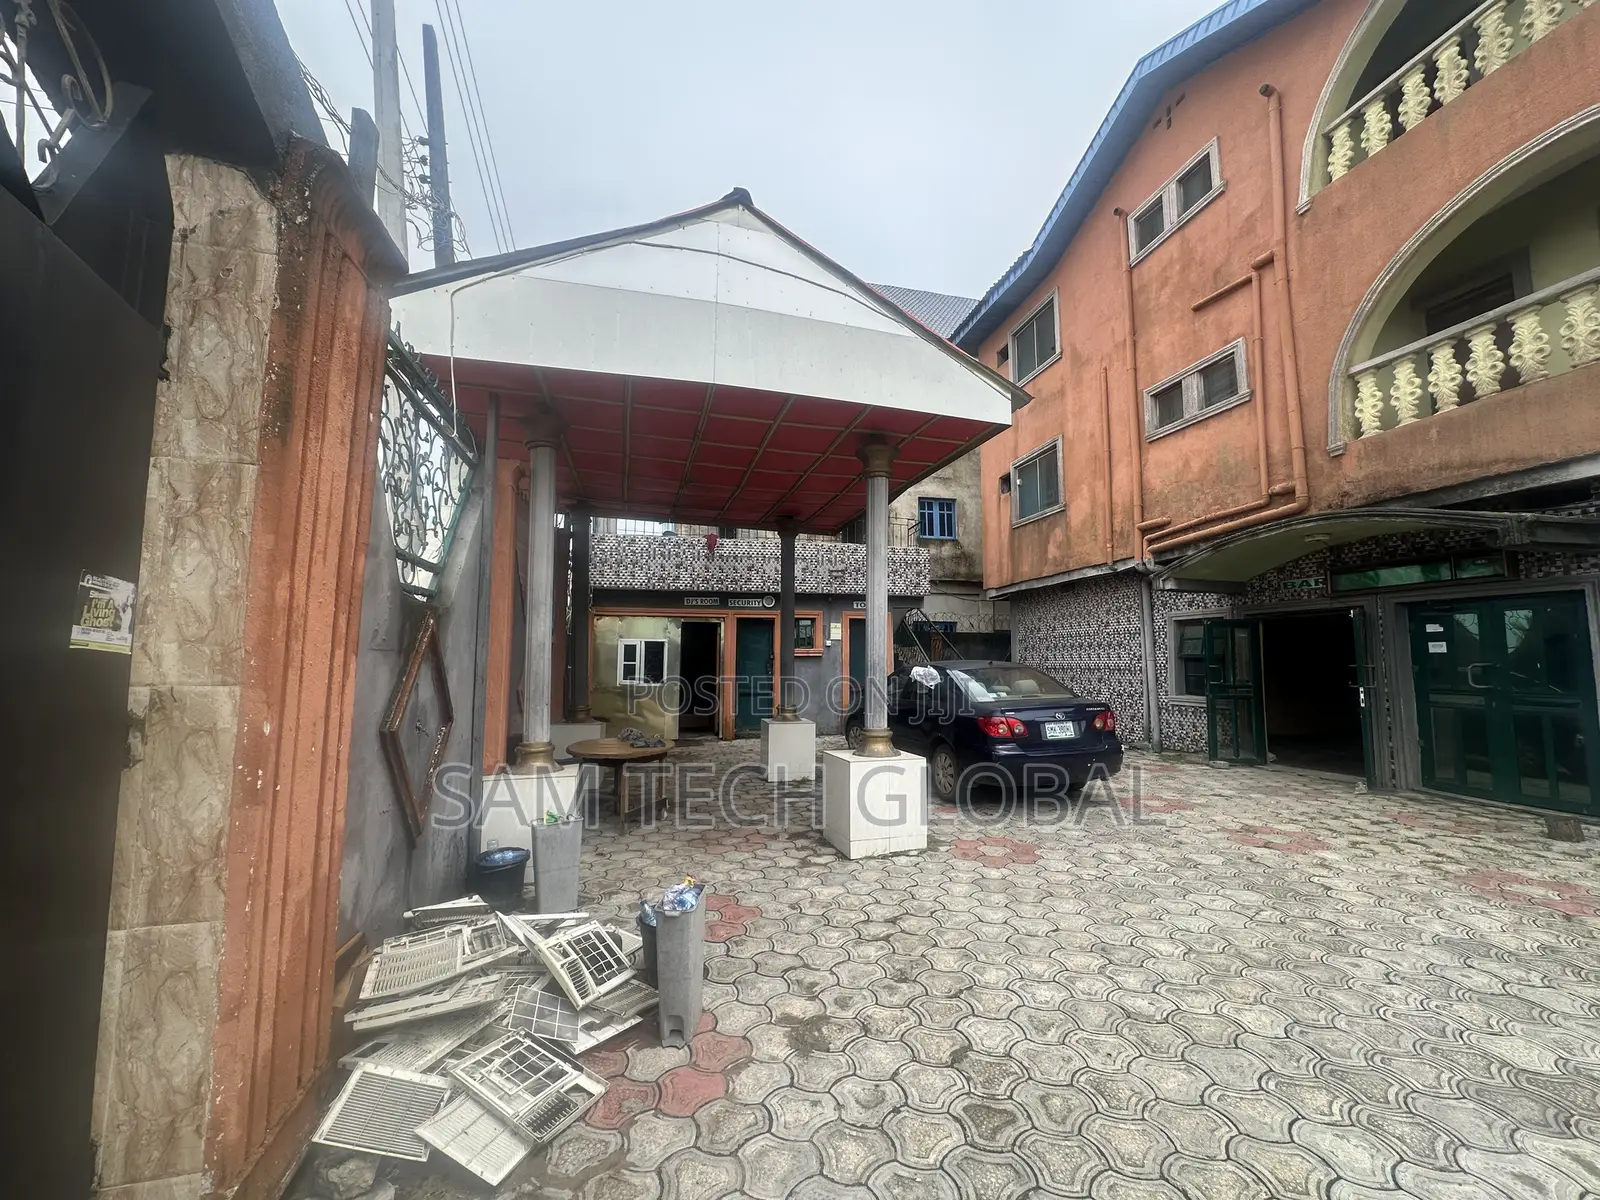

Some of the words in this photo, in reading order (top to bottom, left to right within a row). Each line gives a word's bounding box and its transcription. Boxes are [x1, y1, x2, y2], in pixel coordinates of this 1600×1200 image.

[93, 599, 106, 608] I'm
[108, 599, 115, 608] A
[84, 605, 115, 618] Living
[81, 615, 115, 627] Ghost
